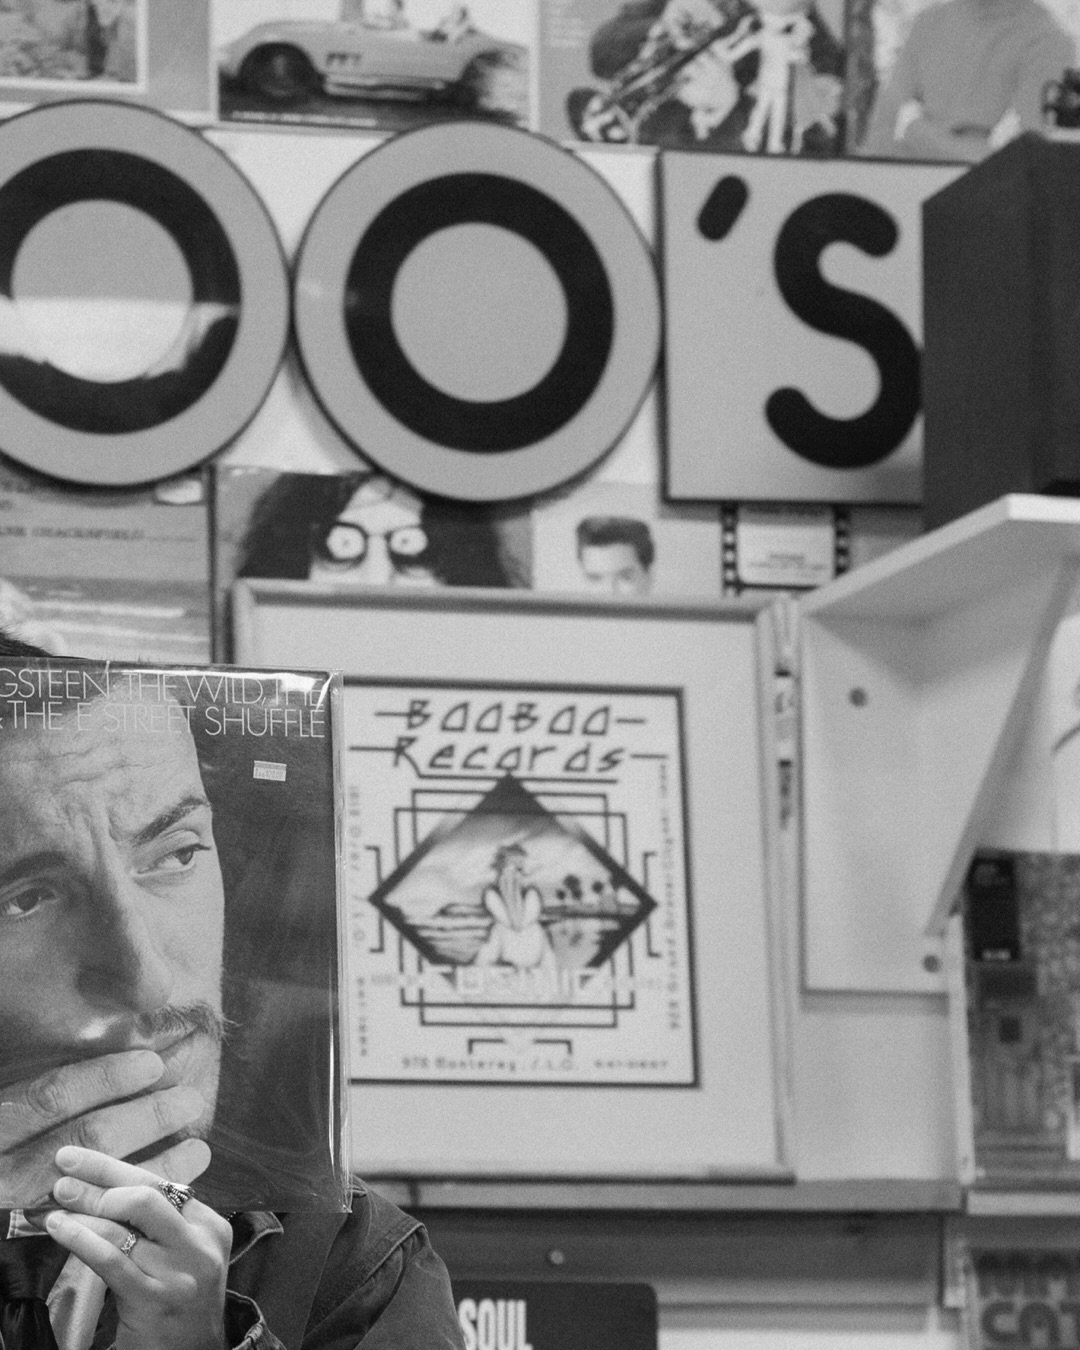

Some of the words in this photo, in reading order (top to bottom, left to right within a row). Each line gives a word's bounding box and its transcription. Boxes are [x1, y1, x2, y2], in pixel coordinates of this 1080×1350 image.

[122, 670, 178, 703] THE
[7, 700, 63, 731] THE
[77, 702, 92, 732] E
[103, 703, 197, 735] STREET
[205, 706, 325, 739] SHUFFLE
[393, 736, 625, 773] Records
